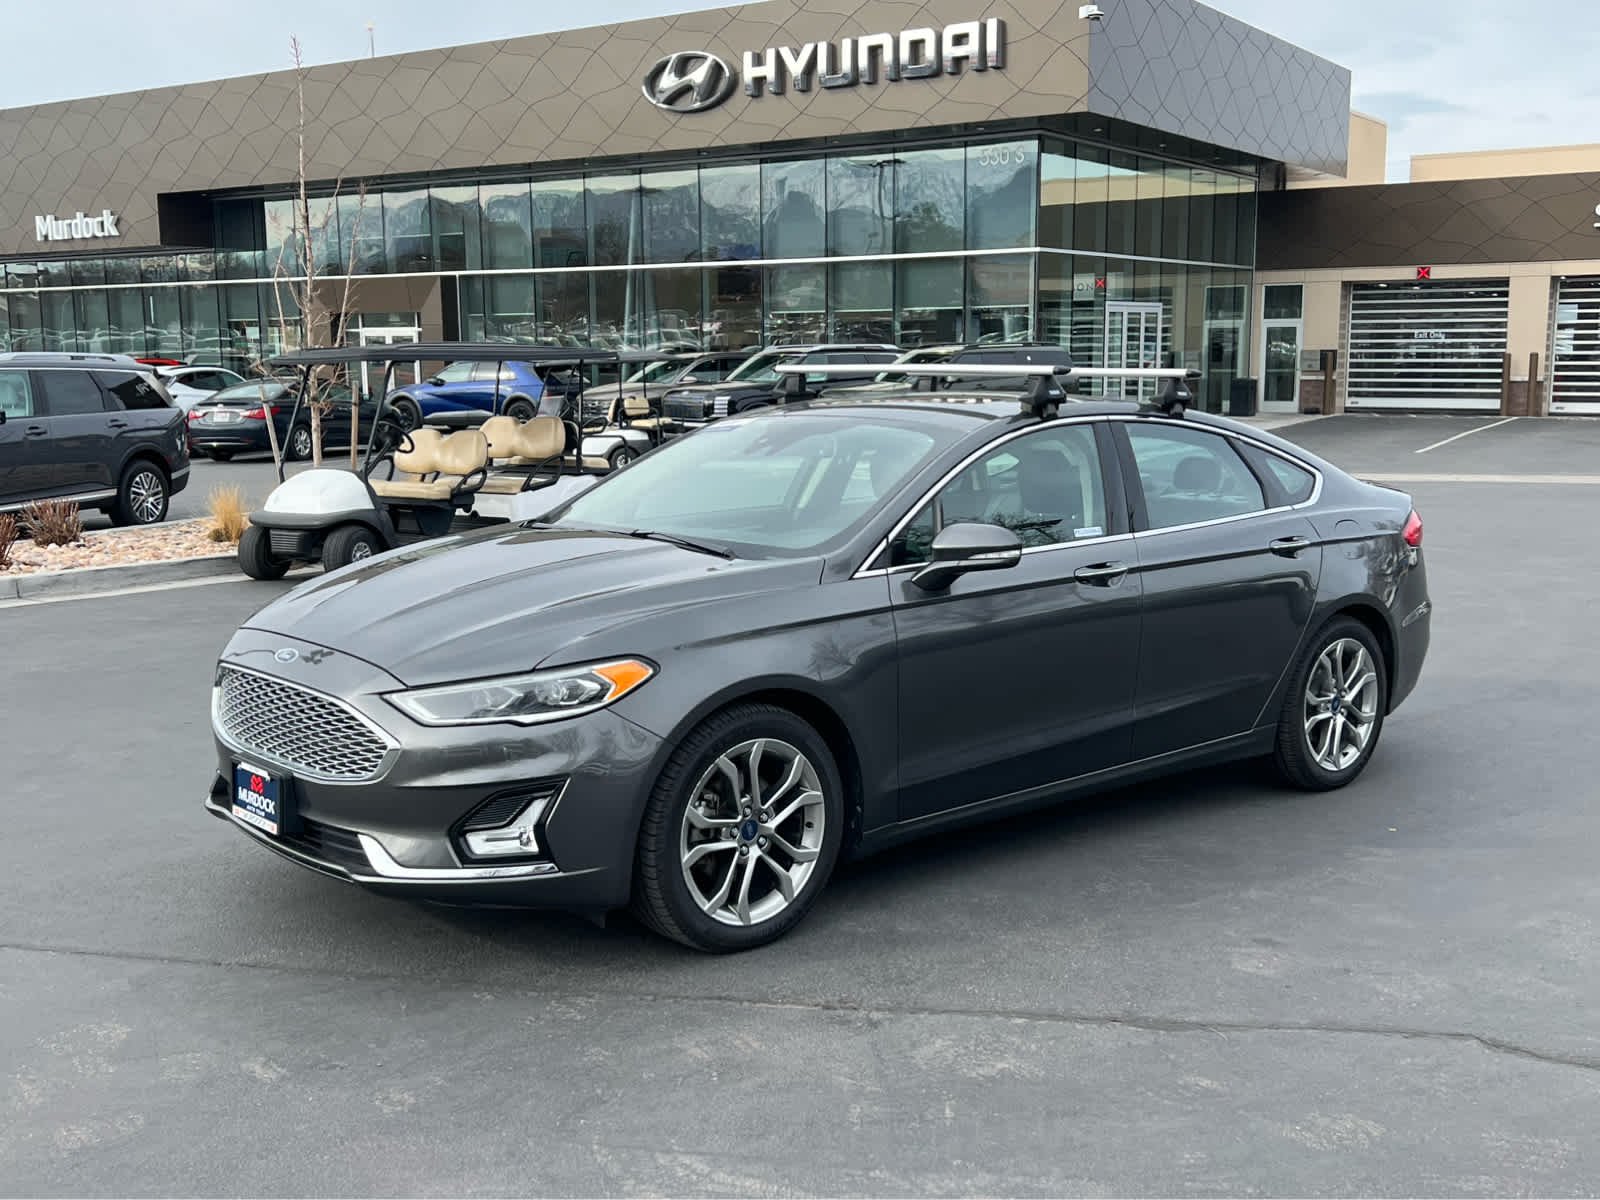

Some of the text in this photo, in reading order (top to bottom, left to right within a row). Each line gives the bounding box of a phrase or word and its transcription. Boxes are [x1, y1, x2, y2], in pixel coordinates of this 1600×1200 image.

[742, 18, 1003, 96] HYUNDAI
[35, 209, 120, 241] Murdock
[238, 786, 275, 815] MURDOCK
